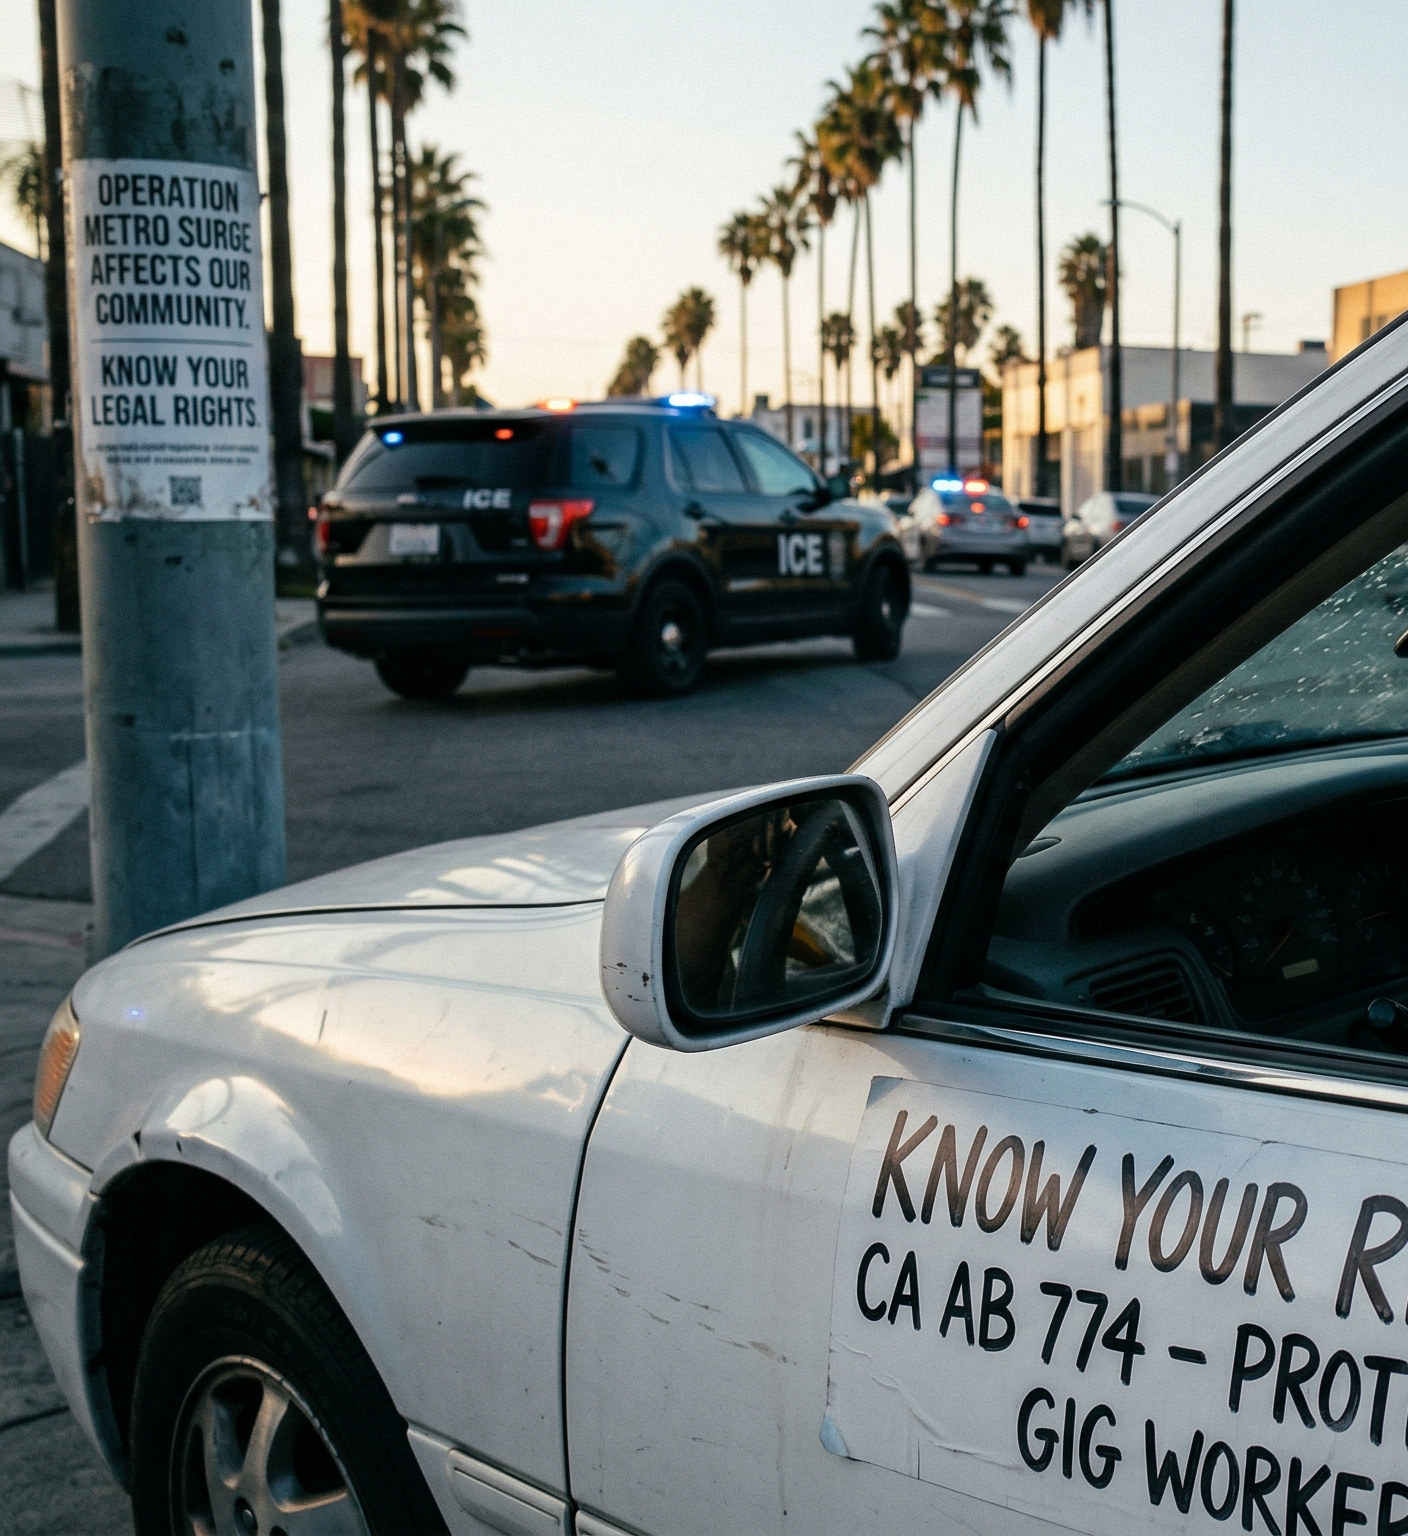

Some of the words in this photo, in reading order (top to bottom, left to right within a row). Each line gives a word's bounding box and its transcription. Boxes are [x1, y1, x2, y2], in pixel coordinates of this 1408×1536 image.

[98, 174, 239, 213] OPERATION
[85, 214, 170, 246] METRO
[178, 216, 252, 253] SURGE
[91, 253, 201, 287] AFFECTS
[209, 257, 251, 291] OUR
[96, 292, 250, 329] COMMUNITY.
[101, 355, 177, 388] KNOW
[186, 356, 249, 389] YOUR
[91, 394, 165, 427] LEGAL
[463, 488, 512, 509] ICE
[777, 533, 823, 575] ICE
[871, 1109, 1097, 1252] KNOW
[1115, 1152, 1308, 1303] YOUR
[856, 1242, 921, 1331] CA
[939, 1260, 1016, 1352] AB
[1039, 1281, 1146, 1387] 774
[1017, 1387, 1122, 1489] GIG
